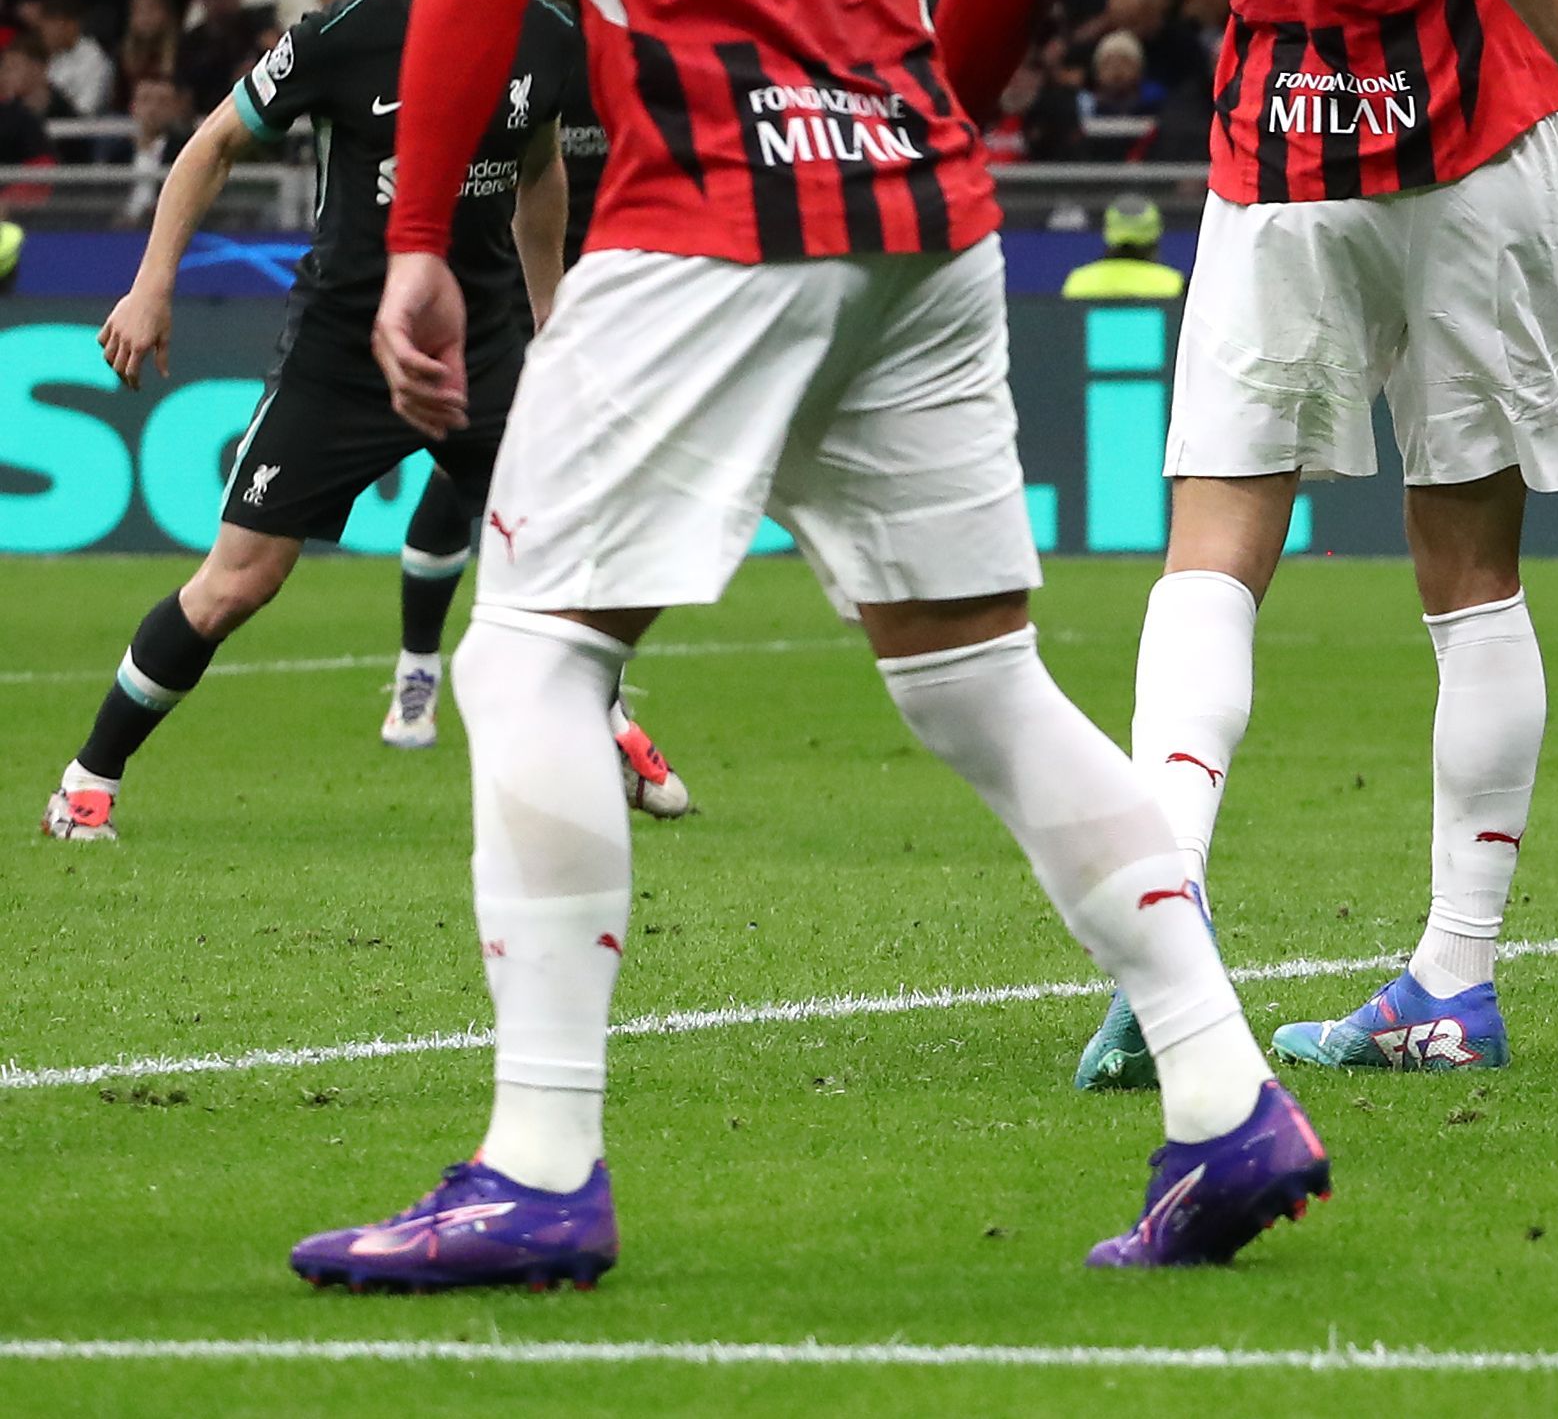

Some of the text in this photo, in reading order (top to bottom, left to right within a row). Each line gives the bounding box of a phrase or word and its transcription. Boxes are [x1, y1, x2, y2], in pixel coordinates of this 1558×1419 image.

[1273, 69, 1411, 95] FONDAZIONE
[747, 85, 906, 121] FONDAZIONE
[1267, 94, 1416, 135] MILAN
[755, 119, 923, 166] MILAN
